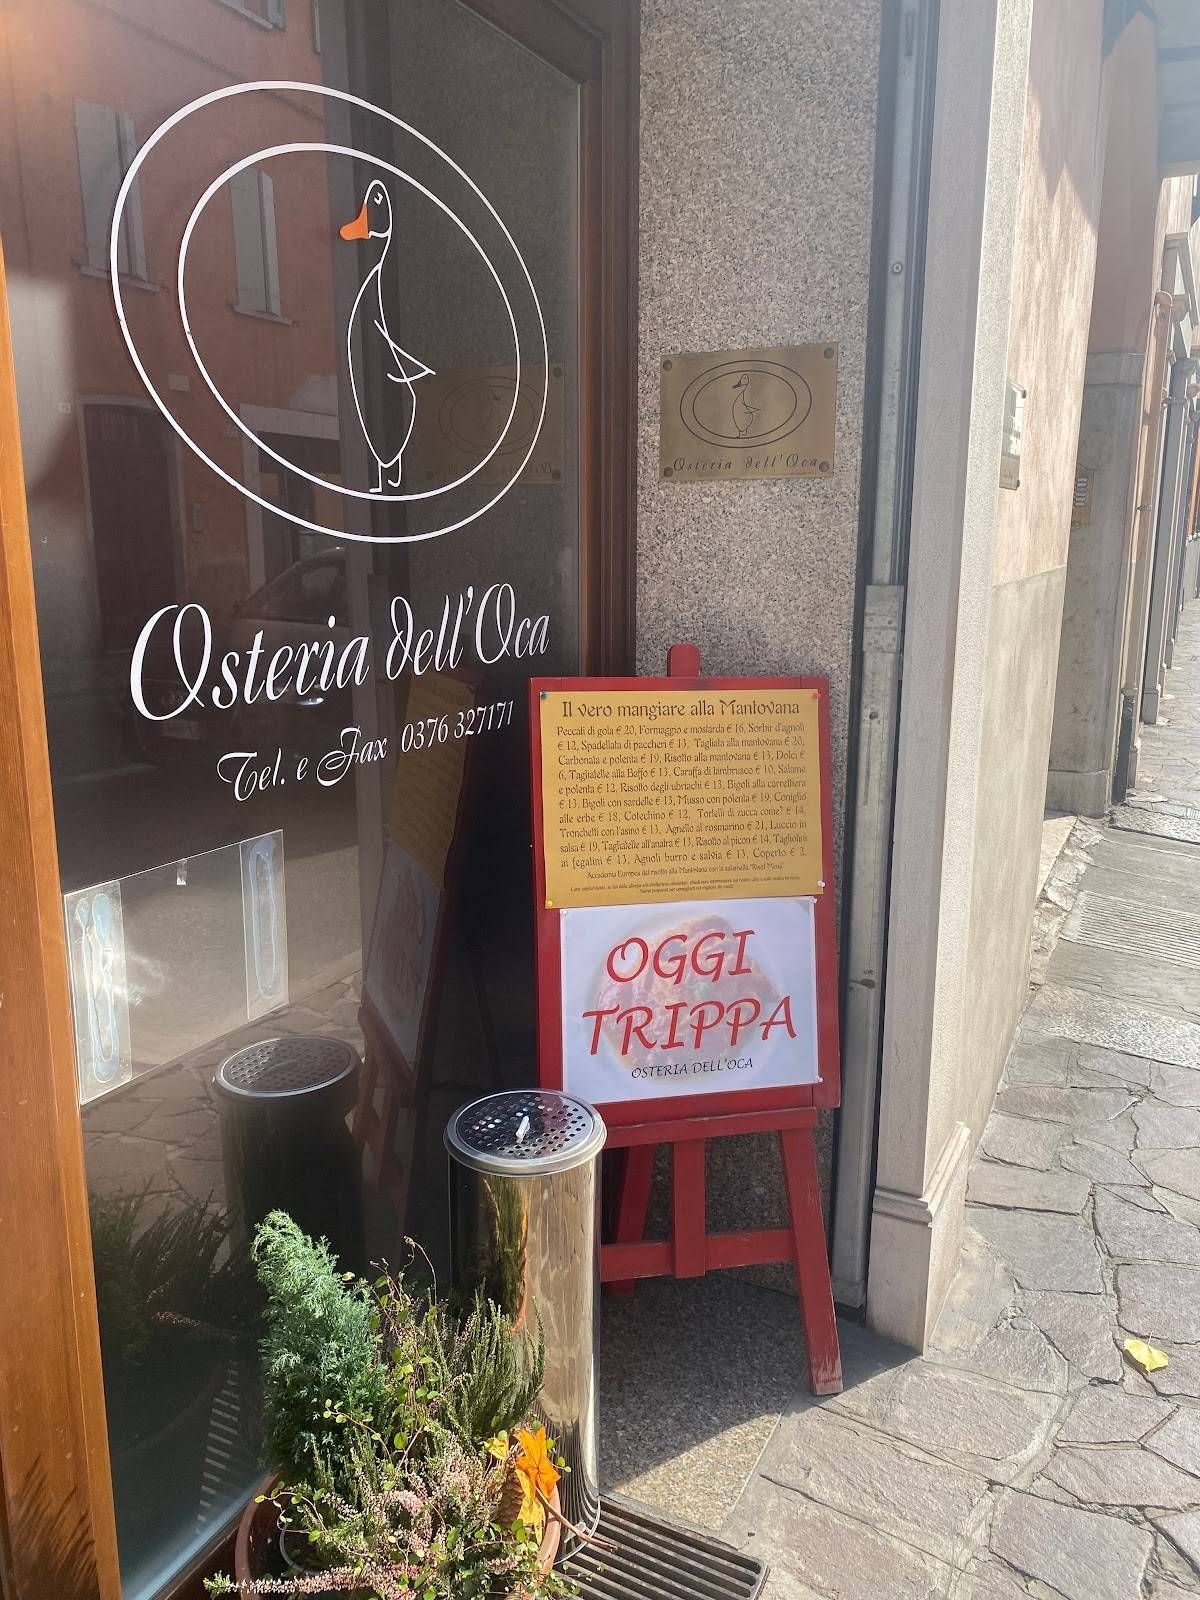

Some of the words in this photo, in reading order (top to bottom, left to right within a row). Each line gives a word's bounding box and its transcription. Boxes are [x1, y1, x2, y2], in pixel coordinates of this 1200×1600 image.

[673, 457, 733, 472] Osteria
[745, 453, 819, 470] dell'Oca
[130, 603, 370, 721] Osteria
[385, 583, 550, 681] dell'Oca
[562, 701, 572, 717] Il
[578, 703, 612, 717] vero
[618, 702, 685, 720] mangiare
[691, 701, 714, 716] alla
[720, 700, 799, 715] Mantovana
[557, 726, 585, 736] Peccati
[588, 726, 596, 735] di
[597, 727, 614, 737] gola
[616, 726, 623, 735] €
[639, 725, 681, 736] Formaggio
[691, 724, 724, 733] mostarda
[727, 724, 734, 733] €
[217, 748, 286, 801] Tel.
[296, 757, 308, 781] e
[316, 725, 388, 787] Fax
[401, 713, 449, 752] 0376
[453, 699, 514, 739] 327171
[558, 742, 565, 750] €
[582, 741, 621, 752] Spadellata
[624, 740, 632, 749] di
[634, 740, 667, 751] paccheri
[669, 739, 675, 748] €
[694, 738, 725, 750] Tagliata
[727, 738, 740, 747] alla
[742, 738, 782, 747] mantovana
[785, 737, 790, 745] €
[559, 756, 600, 765] Carbonata
[610, 755, 638, 765] polenta
[641, 754, 648, 763] €
[664, 753, 691, 763] Risotto
[694, 753, 707, 762] alla
[710, 753, 751, 761] mantovana
[754, 752, 761, 760] €
[776, 751, 797, 760] Dolci
[800, 751, 805, 759] €
[569, 770, 609, 782] Tagliatelle
[612, 769, 625, 778] alla
[627, 768, 647, 780] Baffo
[650, 769, 657, 777] €
[674, 767, 702, 779] Caraffa
[704, 767, 711, 775] di
[713, 766, 753, 775] lambrusco
[755, 766, 761, 774] €
[566, 784, 594, 796] polenta
[597, 784, 603, 793] €
[620, 783, 648, 792] Risotto
[651, 783, 669, 793] degli
[671, 782, 702, 792] ubriachi
[705, 781, 710, 789] €
[727, 780, 750, 791] Bigoli
[753, 780, 766, 789] alla
[559, 800, 565, 809] €
[582, 798, 605, 810] Bigoli
[624, 797, 653, 806] sardelle
[656, 797, 662, 805] €
[678, 795, 704, 805] Musso
[723, 794, 749, 805] polenta
[752, 793, 758, 801] €
[774, 792, 806, 803] Coniglio
[559, 814, 573, 824] alle
[577, 814, 595, 823] erbe
[599, 813, 605, 822] €
[624, 811, 665, 821] Cotechino
[669, 810, 675, 819] €
[697, 808, 724, 818] Tortelli
[728, 807, 735, 816] di
[738, 808, 757, 816] zucca
[760, 806, 783, 815] come?
[617, 826, 639, 836] l'asino
[642, 826, 647, 834] €
[666, 823, 694, 835] Agnello
[696, 823, 703, 832] al
[705, 822, 744, 831] rosmarino
[747, 822, 753, 830] €
[770, 820, 796, 829] Luccio
[560, 843, 578, 853] salsa
[581, 843, 586, 851] €
[602, 840, 639, 852] Tagliatelle
[675, 838, 681, 847] €
[696, 836, 721, 846] Risotto
[723, 836, 729, 844] al
[753, 835, 759, 843] €
[561, 858, 568, 867] ai
[607, 856, 612, 865] €
[634, 854, 661, 866] Agnoli
[665, 853, 687, 862] burro
[700, 851, 722, 860] salvia
[727, 850, 732, 859] €
[753, 849, 786, 859] Coperto
[790, 848, 796, 856] €
[606, 929, 755, 985] OGGI
[582, 995, 797, 1056] TRIPPA
[631, 1063, 688, 1079] OSTERIA
[692, 1057, 753, 1074] DELL'OCA
